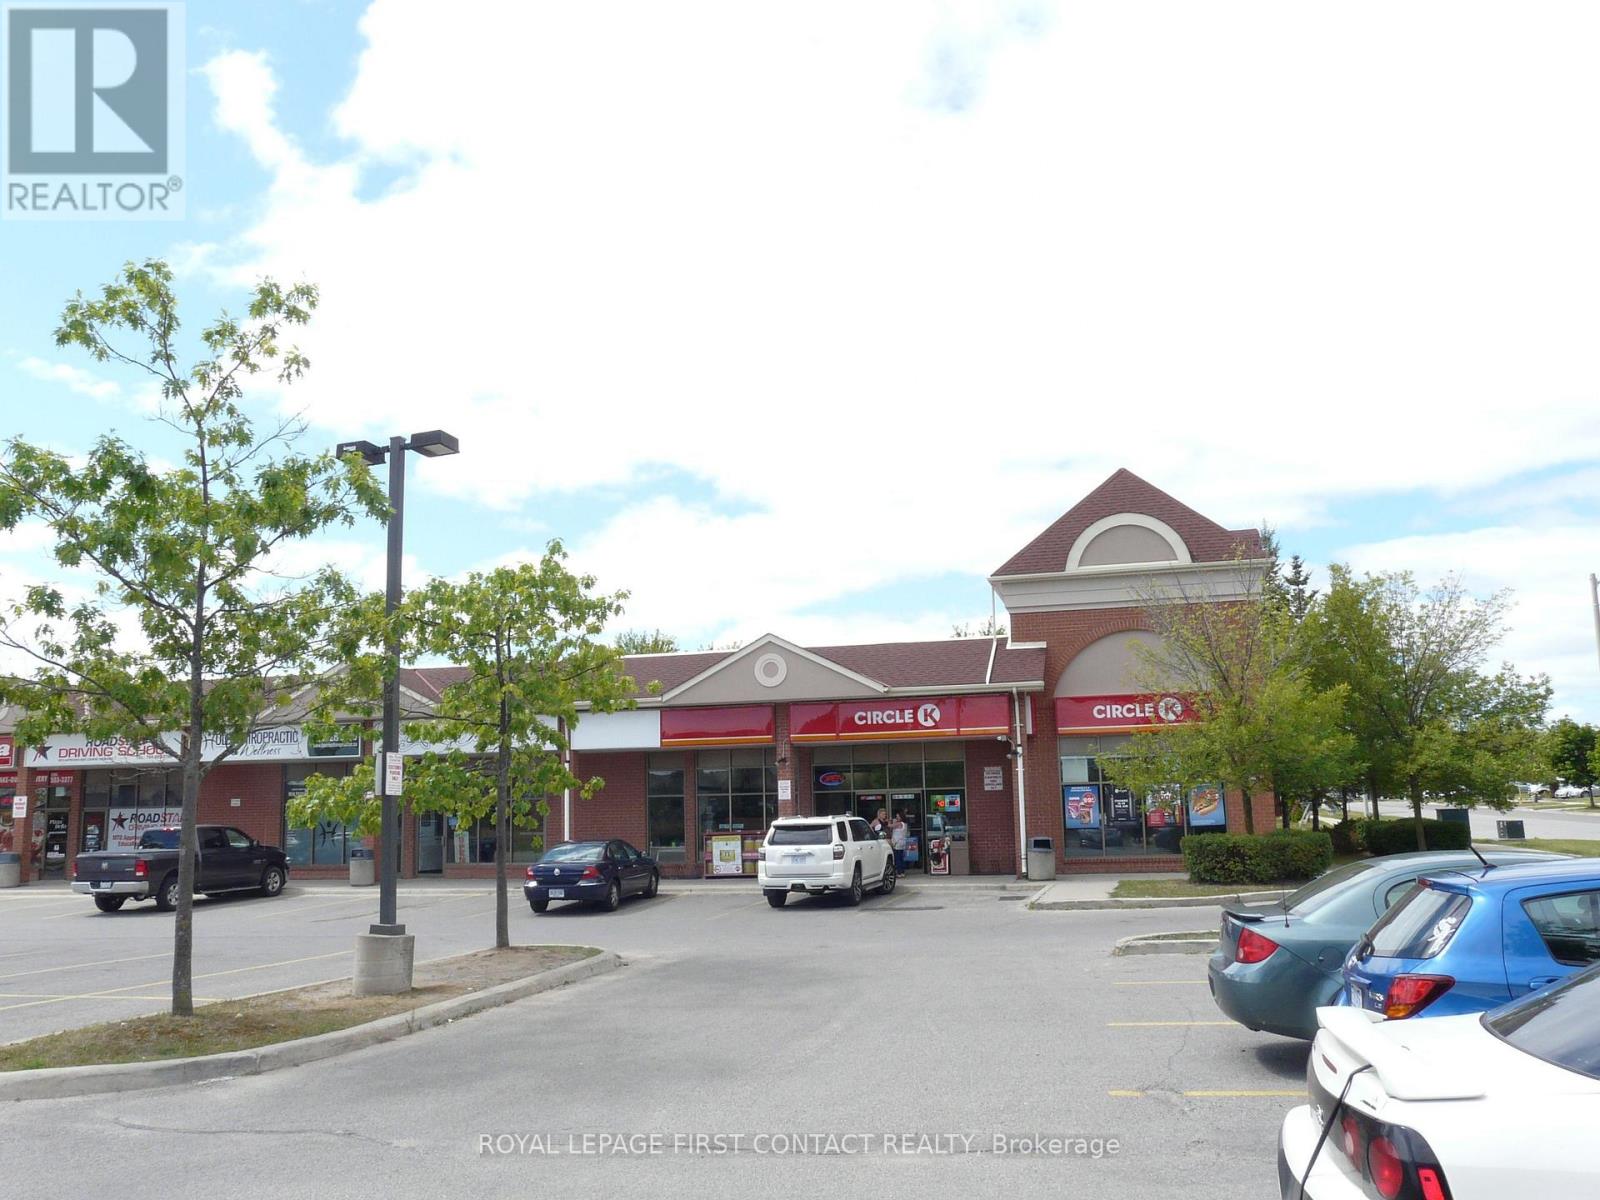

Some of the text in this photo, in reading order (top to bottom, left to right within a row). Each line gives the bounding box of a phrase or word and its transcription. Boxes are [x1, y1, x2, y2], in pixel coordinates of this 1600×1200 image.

[854, 706, 939, 725] CIRCLE K
[1093, 703, 1154, 719] CIRCLE
[58, 746, 113, 758] DRIVING
[129, 812, 183, 824] ROADSTA
